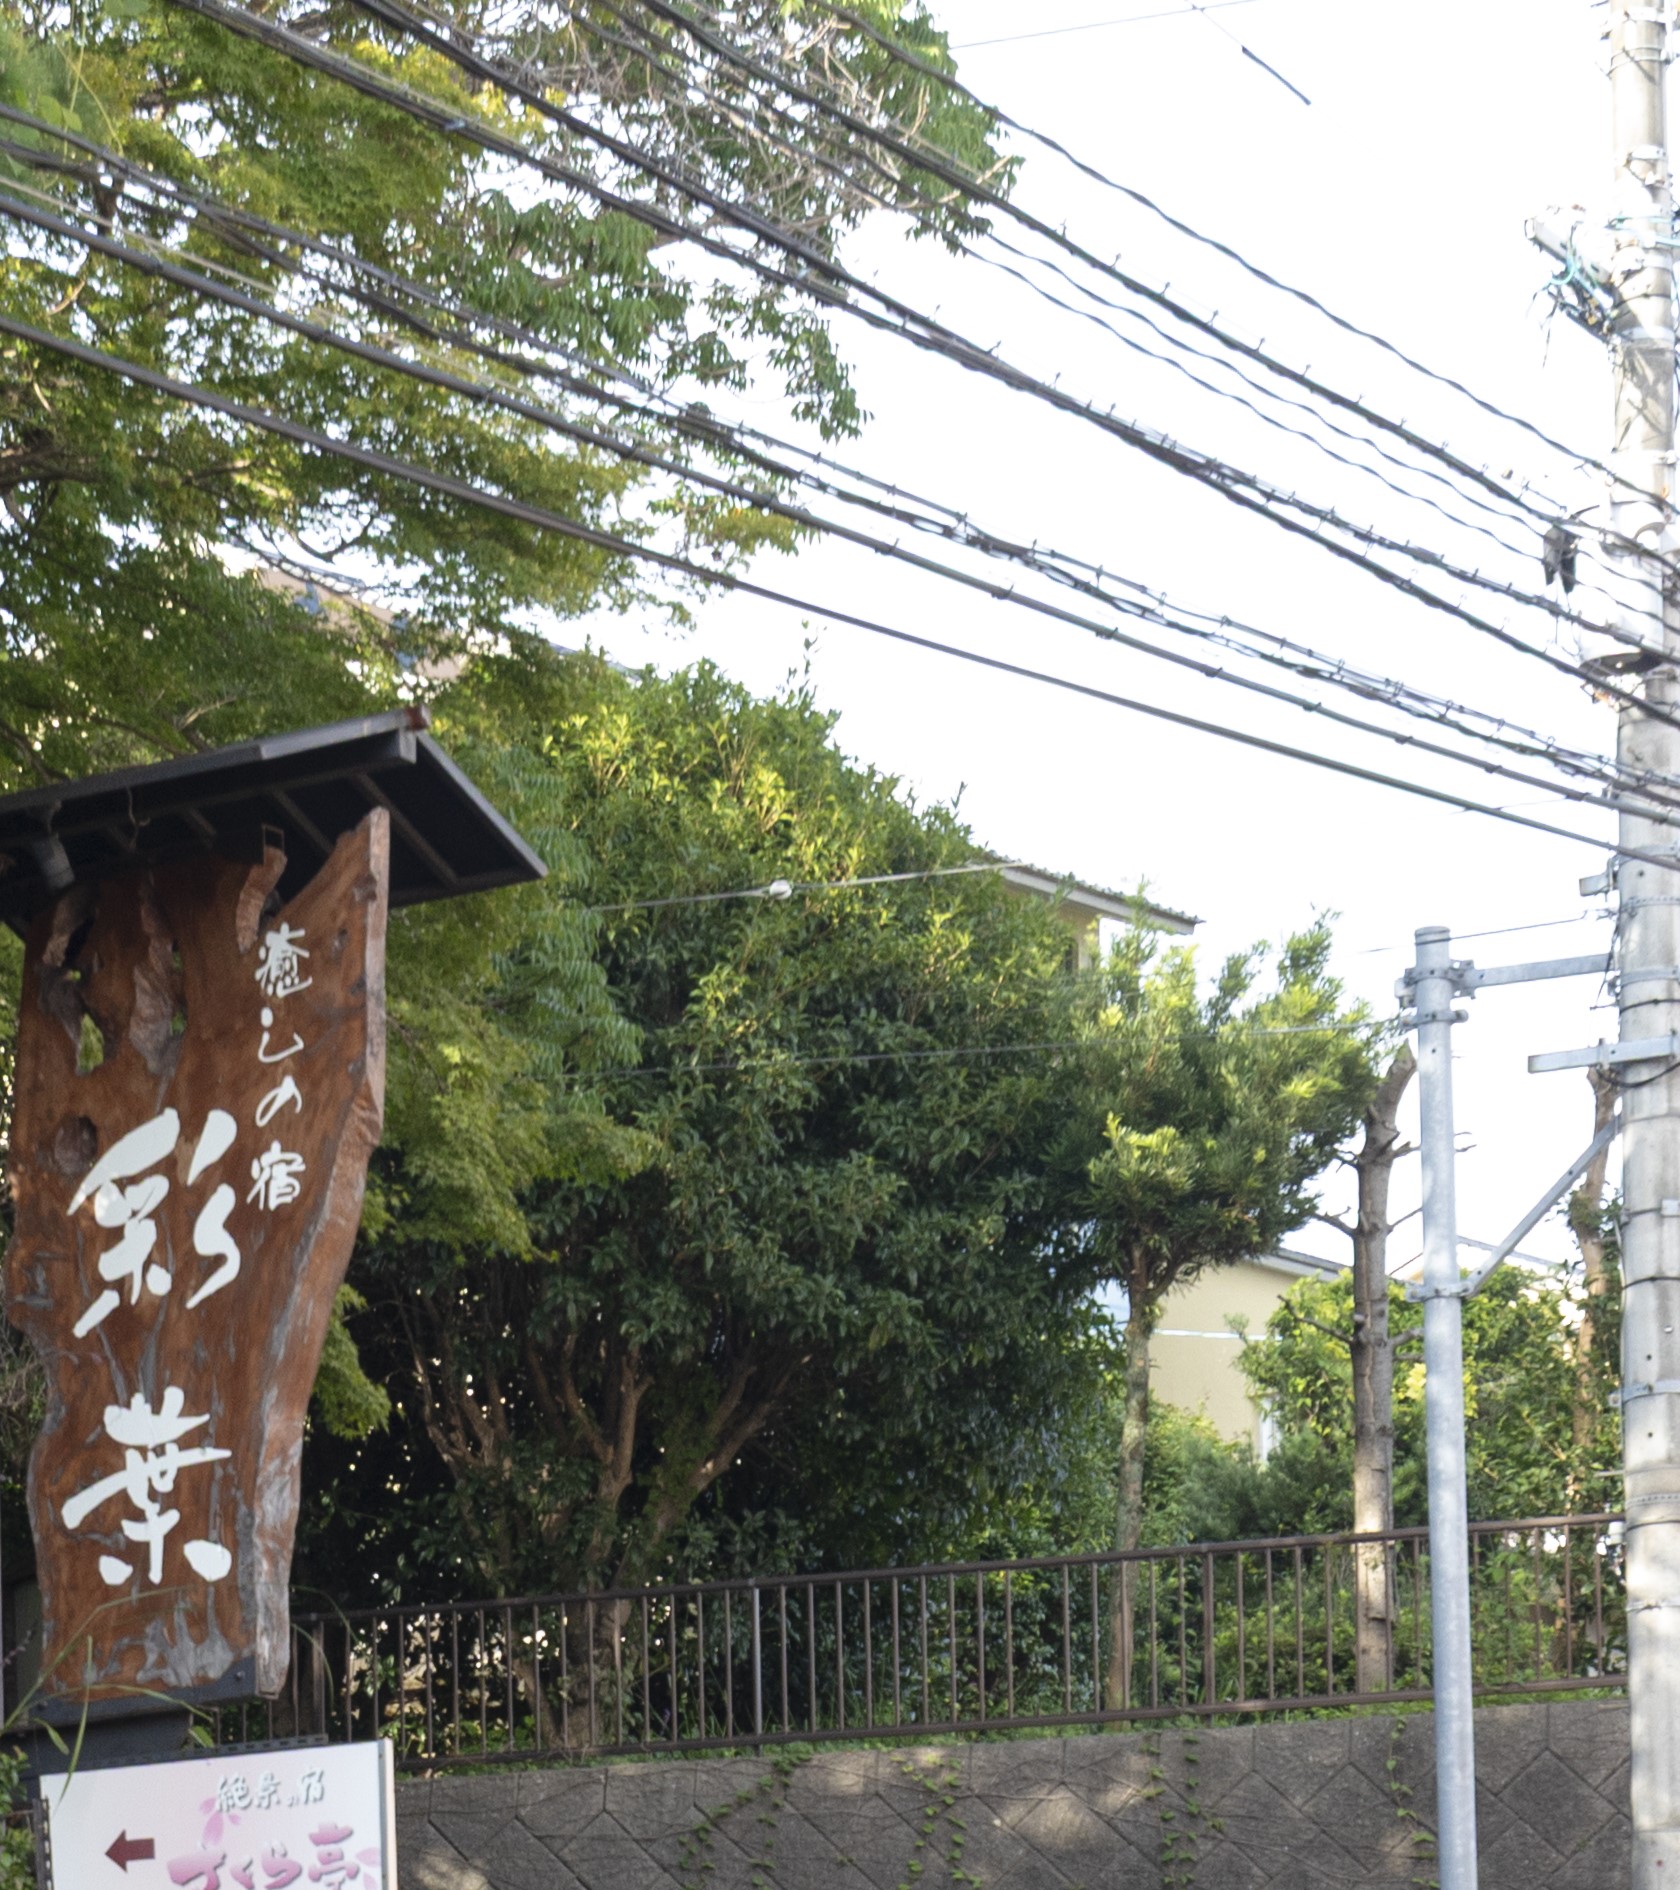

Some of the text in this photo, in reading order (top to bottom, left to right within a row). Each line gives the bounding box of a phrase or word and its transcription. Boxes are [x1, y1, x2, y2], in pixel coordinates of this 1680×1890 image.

[247, 921, 313, 1211] 癒しの宿
[61, 1106, 241, 1585] 彩葉
